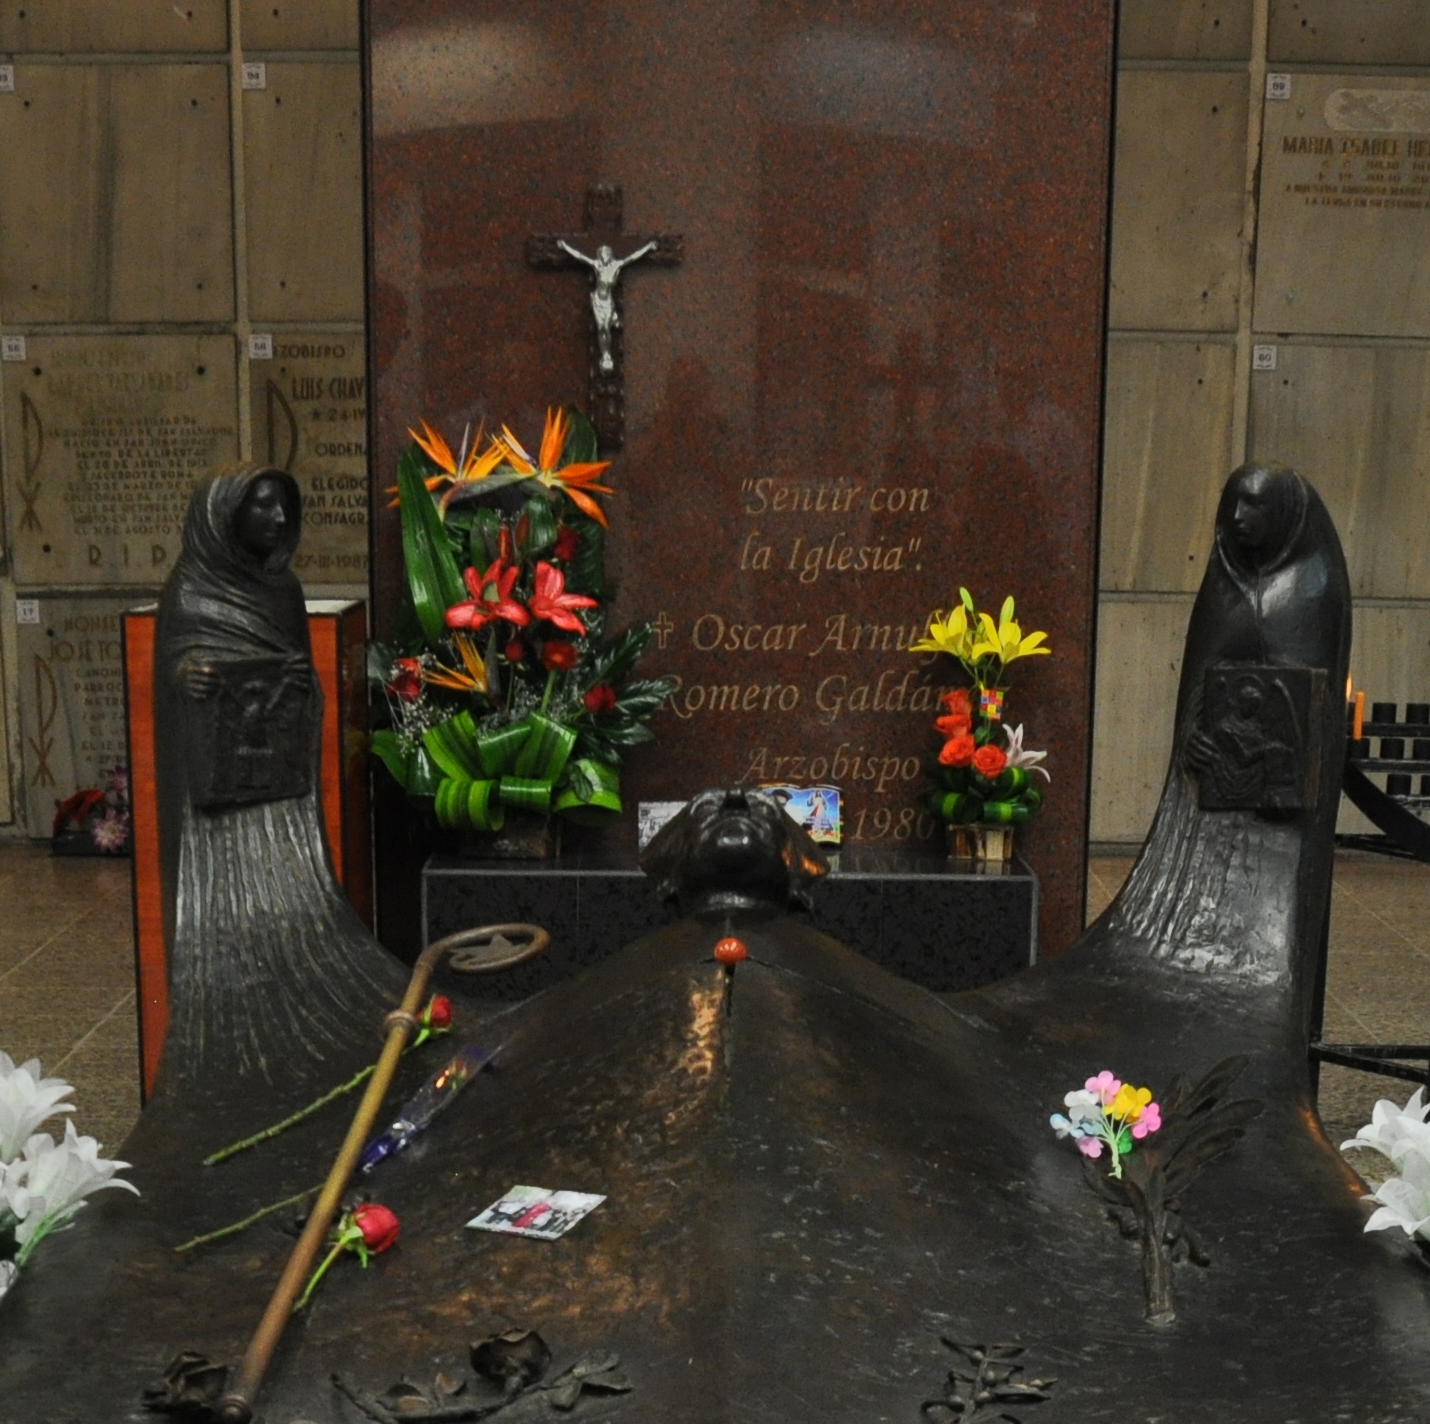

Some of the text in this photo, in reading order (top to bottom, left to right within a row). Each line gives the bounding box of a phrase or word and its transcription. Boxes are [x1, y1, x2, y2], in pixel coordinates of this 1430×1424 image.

[1283, 136, 1334, 155] MARIA
[292, 376, 323, 400] LUIS
[741, 475, 930, 515] "Sentir con
[740, 528, 922, 584] la Iglesia".
[691, 613, 807, 651] Oscar
[659, 673, 799, 719] Romero
[735, 743, 921, 794] Arzobispo
